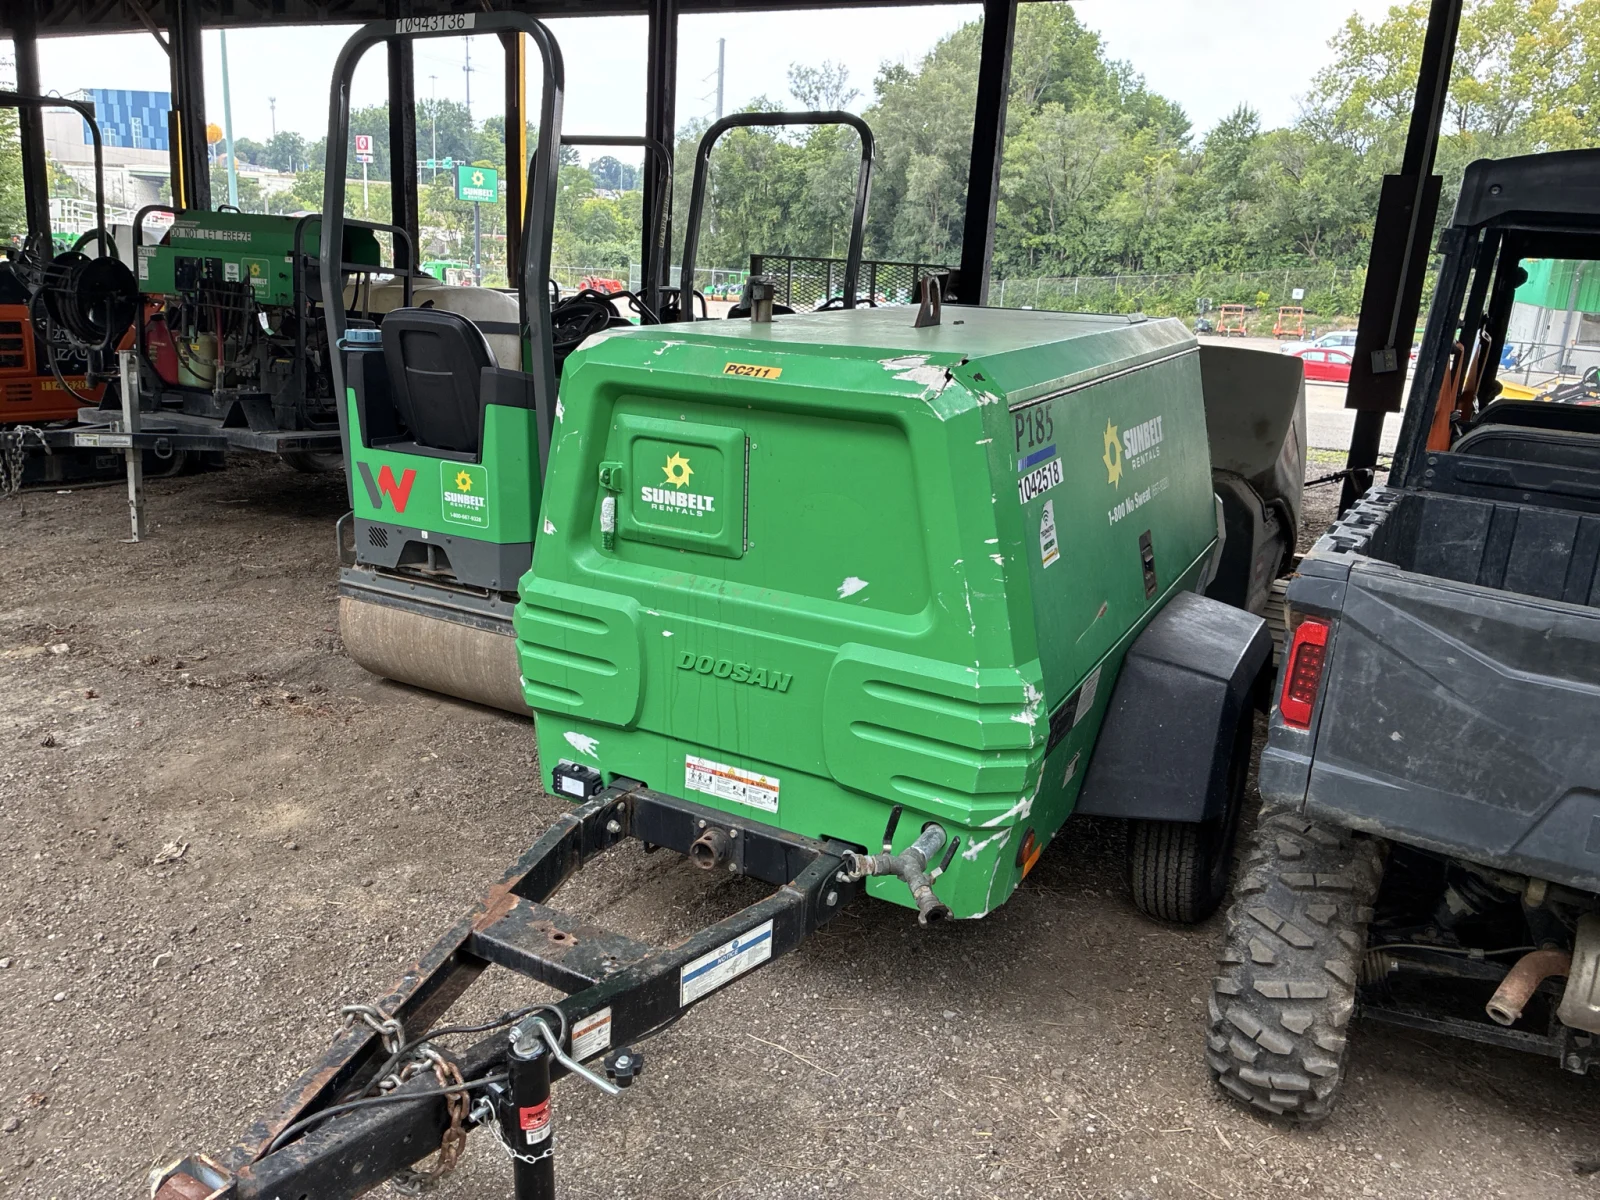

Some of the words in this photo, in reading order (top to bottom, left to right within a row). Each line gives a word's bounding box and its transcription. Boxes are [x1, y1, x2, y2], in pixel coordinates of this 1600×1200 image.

[398, 14, 465, 32] 10943136
[463, 187, 493, 197] SUNBELT
[171, 228, 180, 237] DO
[185, 228, 198, 238] NOT
[203, 230, 217, 240] LET
[222, 231, 251, 242] FREEZE
[725, 365, 770, 378] PC211
[1015, 404, 1053, 452] P185
[1123, 415, 1163, 460] SUNBELT
[1132, 446, 1161, 470] RENTALS
[1018, 461, 1060, 502] 1042518
[444, 491, 485, 507] SUNBELT
[450, 502, 479, 511] RENTALS
[641, 486, 715, 512] SUNBELT
[651, 503, 703, 517] RENTALS
[1108, 502, 1126, 526] 1-800
[677, 650, 793, 693] DOOSAN
[717, 949, 739, 964] NOTICE
